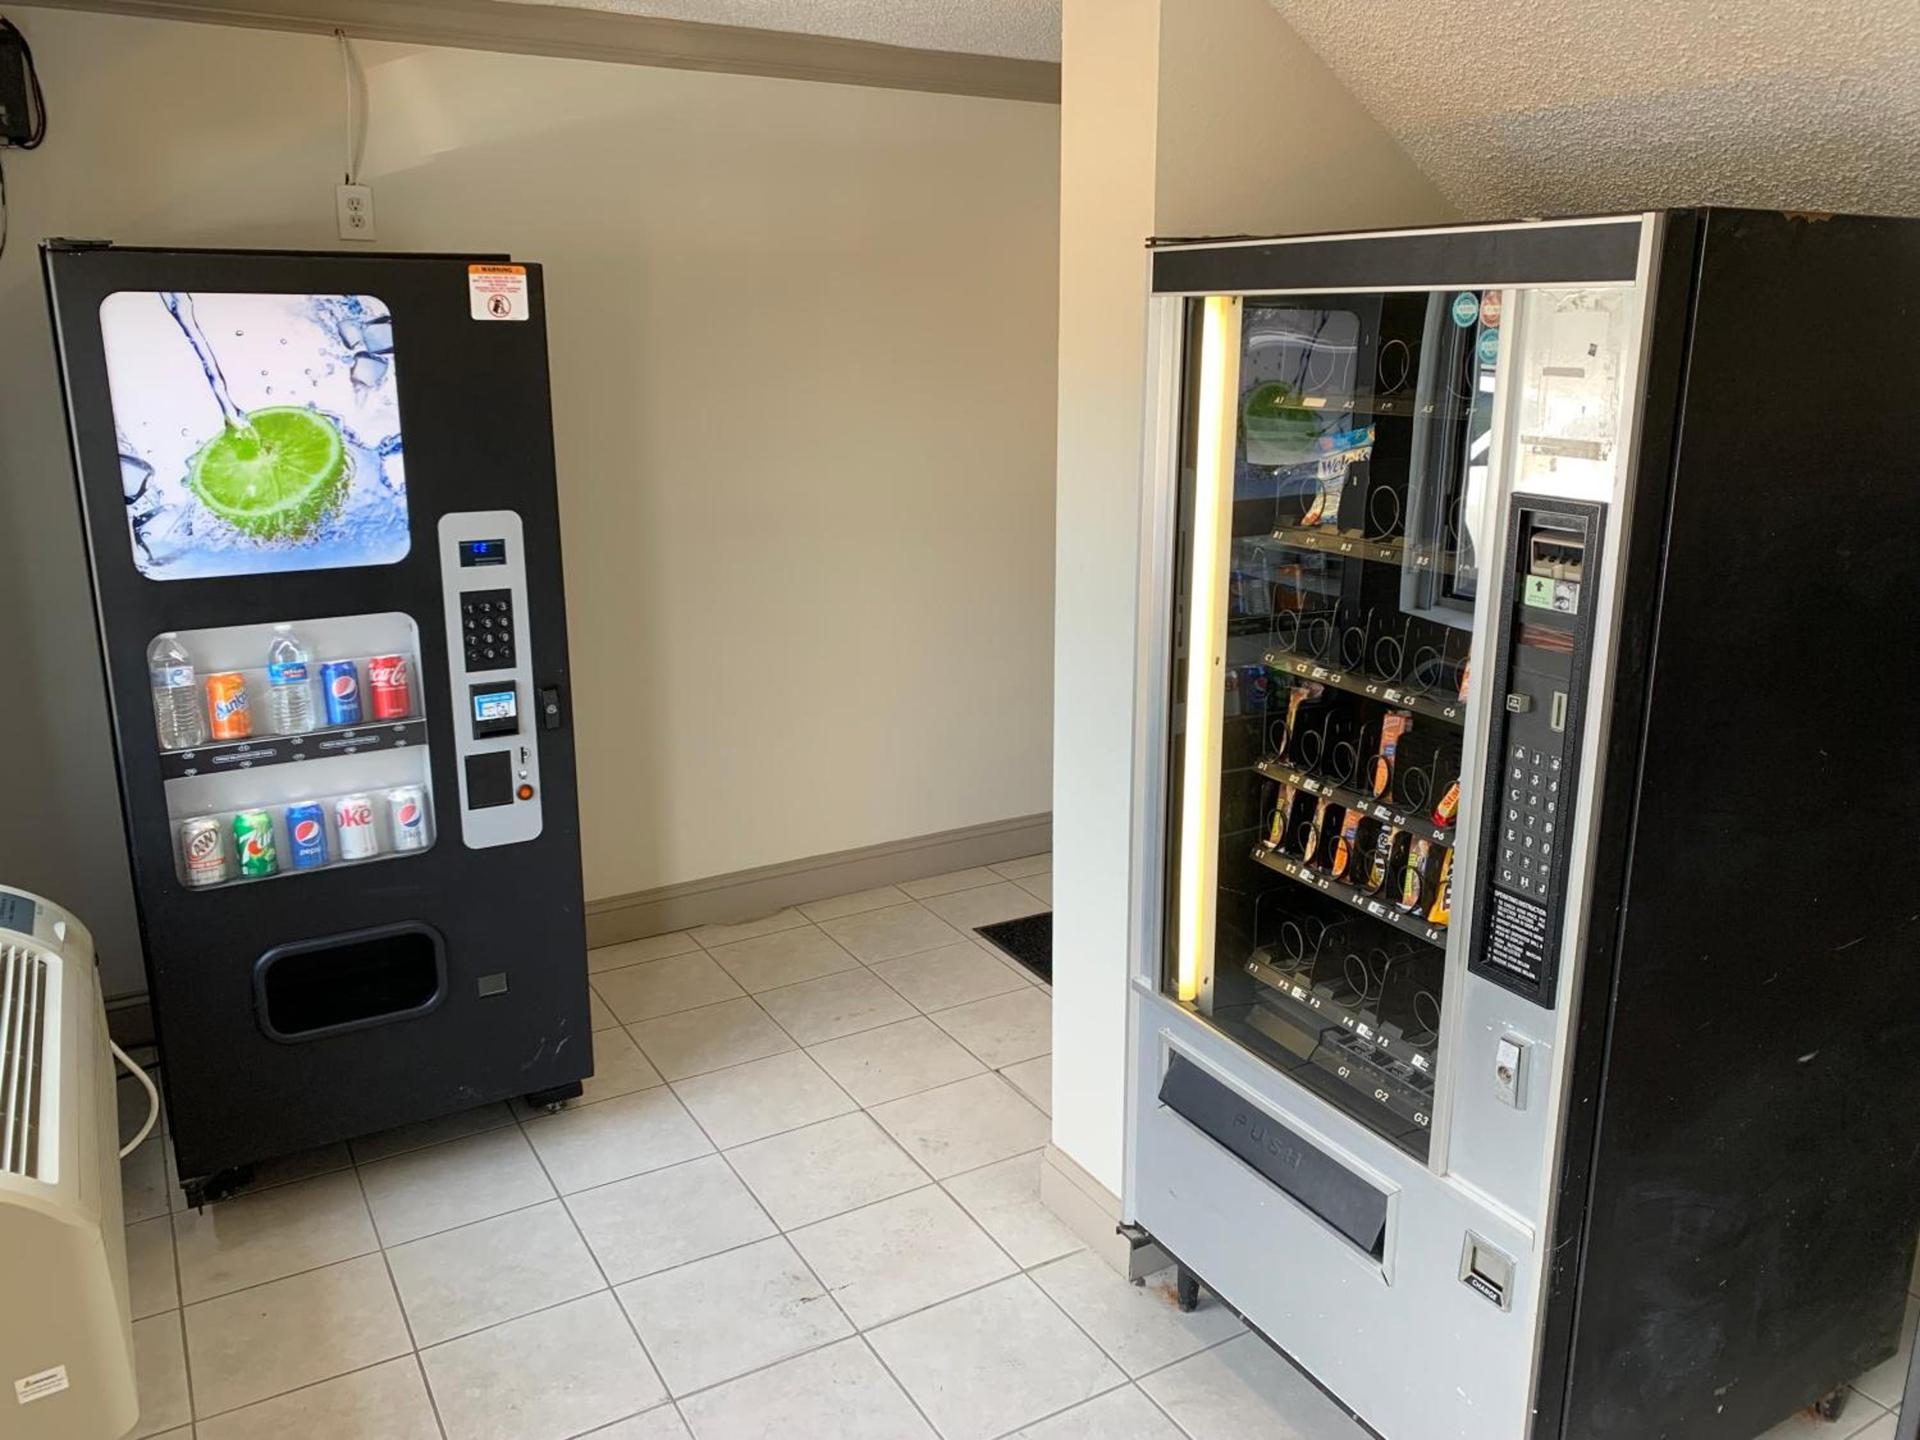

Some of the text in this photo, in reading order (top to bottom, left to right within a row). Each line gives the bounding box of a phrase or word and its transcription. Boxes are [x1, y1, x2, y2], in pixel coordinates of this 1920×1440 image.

[1265, 654, 1274, 662] C1
[1366, 685, 1377, 694] C4
[1443, 707, 1456, 718] C6
[1258, 762, 1267, 771] D1
[1289, 774, 1300, 783] D2
[1357, 801, 1368, 810] D4
[1393, 815, 1405, 825] D5
[1433, 830, 1445, 840] D6
[1352, 894, 1364, 905] E4
[1388, 911, 1400, 922] E5
[1426, 929, 1438, 940] E6
[1338, 1066, 1350, 1078] G1
[1374, 1089, 1389, 1102] G2
[1414, 1112, 1429, 1126] G3
[1232, 1114, 1302, 1170] PUSH
[1472, 1279, 1497, 1300] CHANGE
